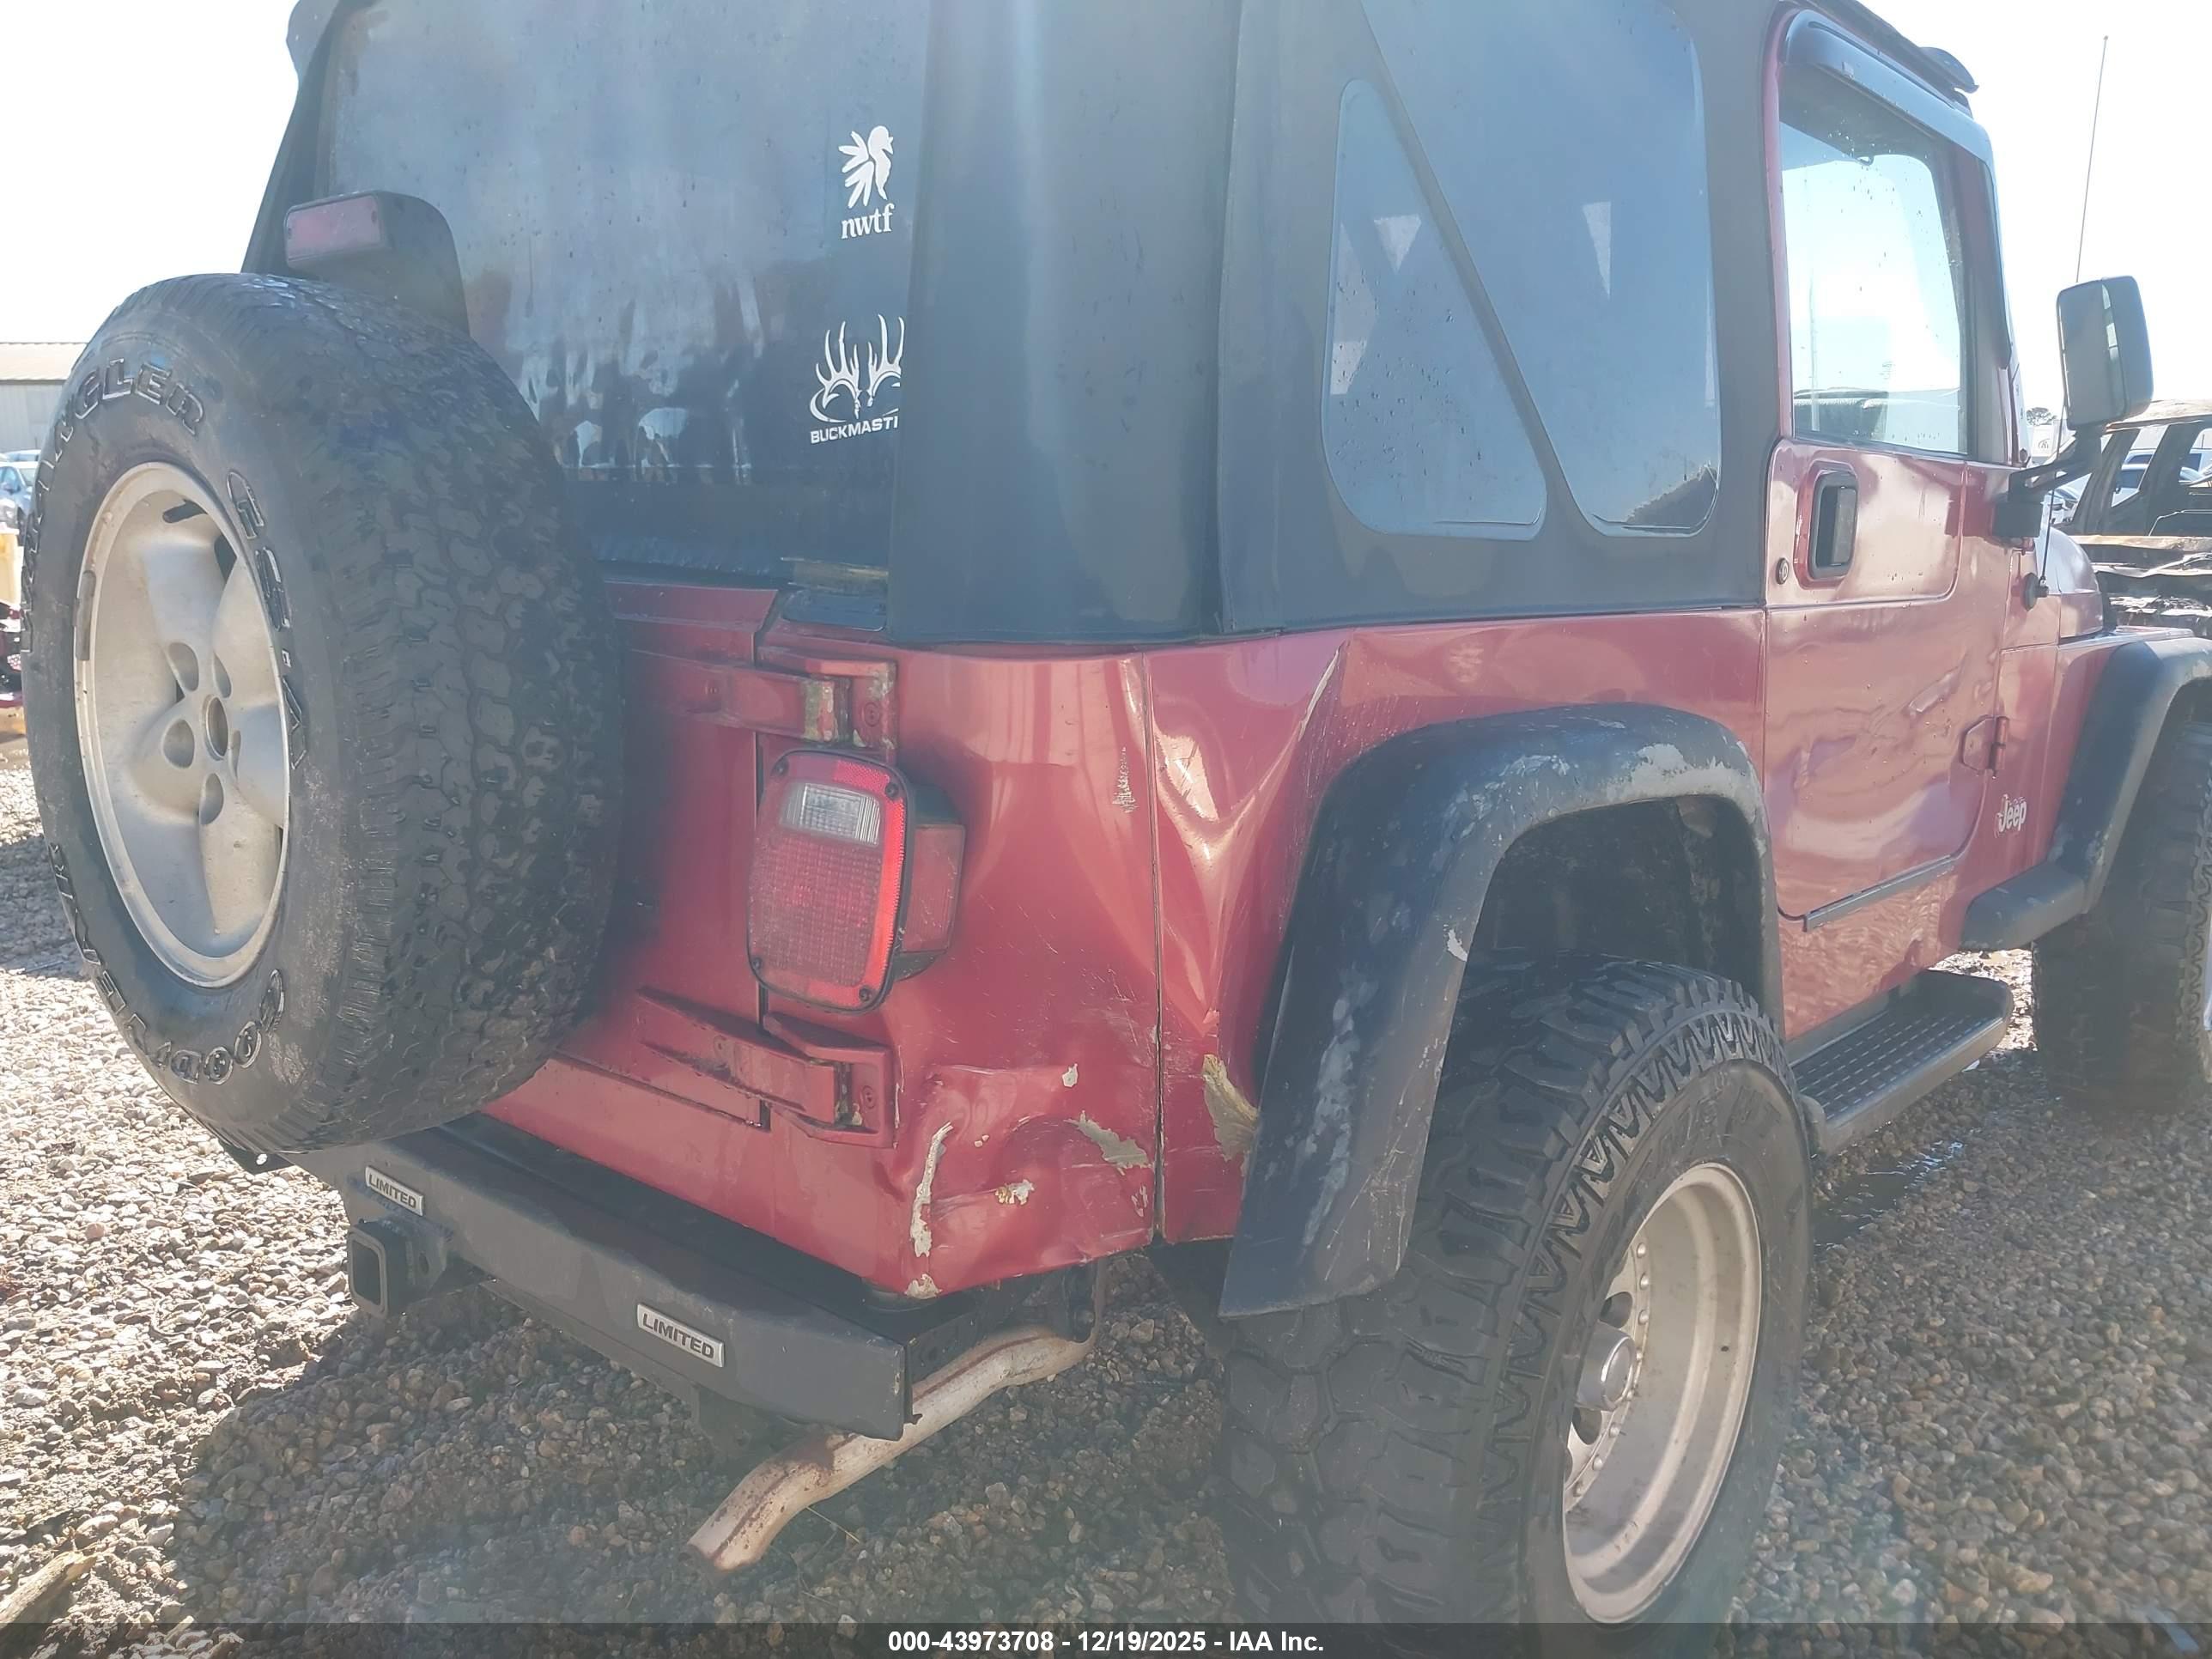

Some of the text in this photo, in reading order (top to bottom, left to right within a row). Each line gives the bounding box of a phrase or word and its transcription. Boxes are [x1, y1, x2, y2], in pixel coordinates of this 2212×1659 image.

[841, 203, 895, 240] nwtf
[1996, 799, 2027, 833] Jeep
[368, 1173, 416, 1209] LIMITED
[642, 1312, 714, 1359] LIMITED
